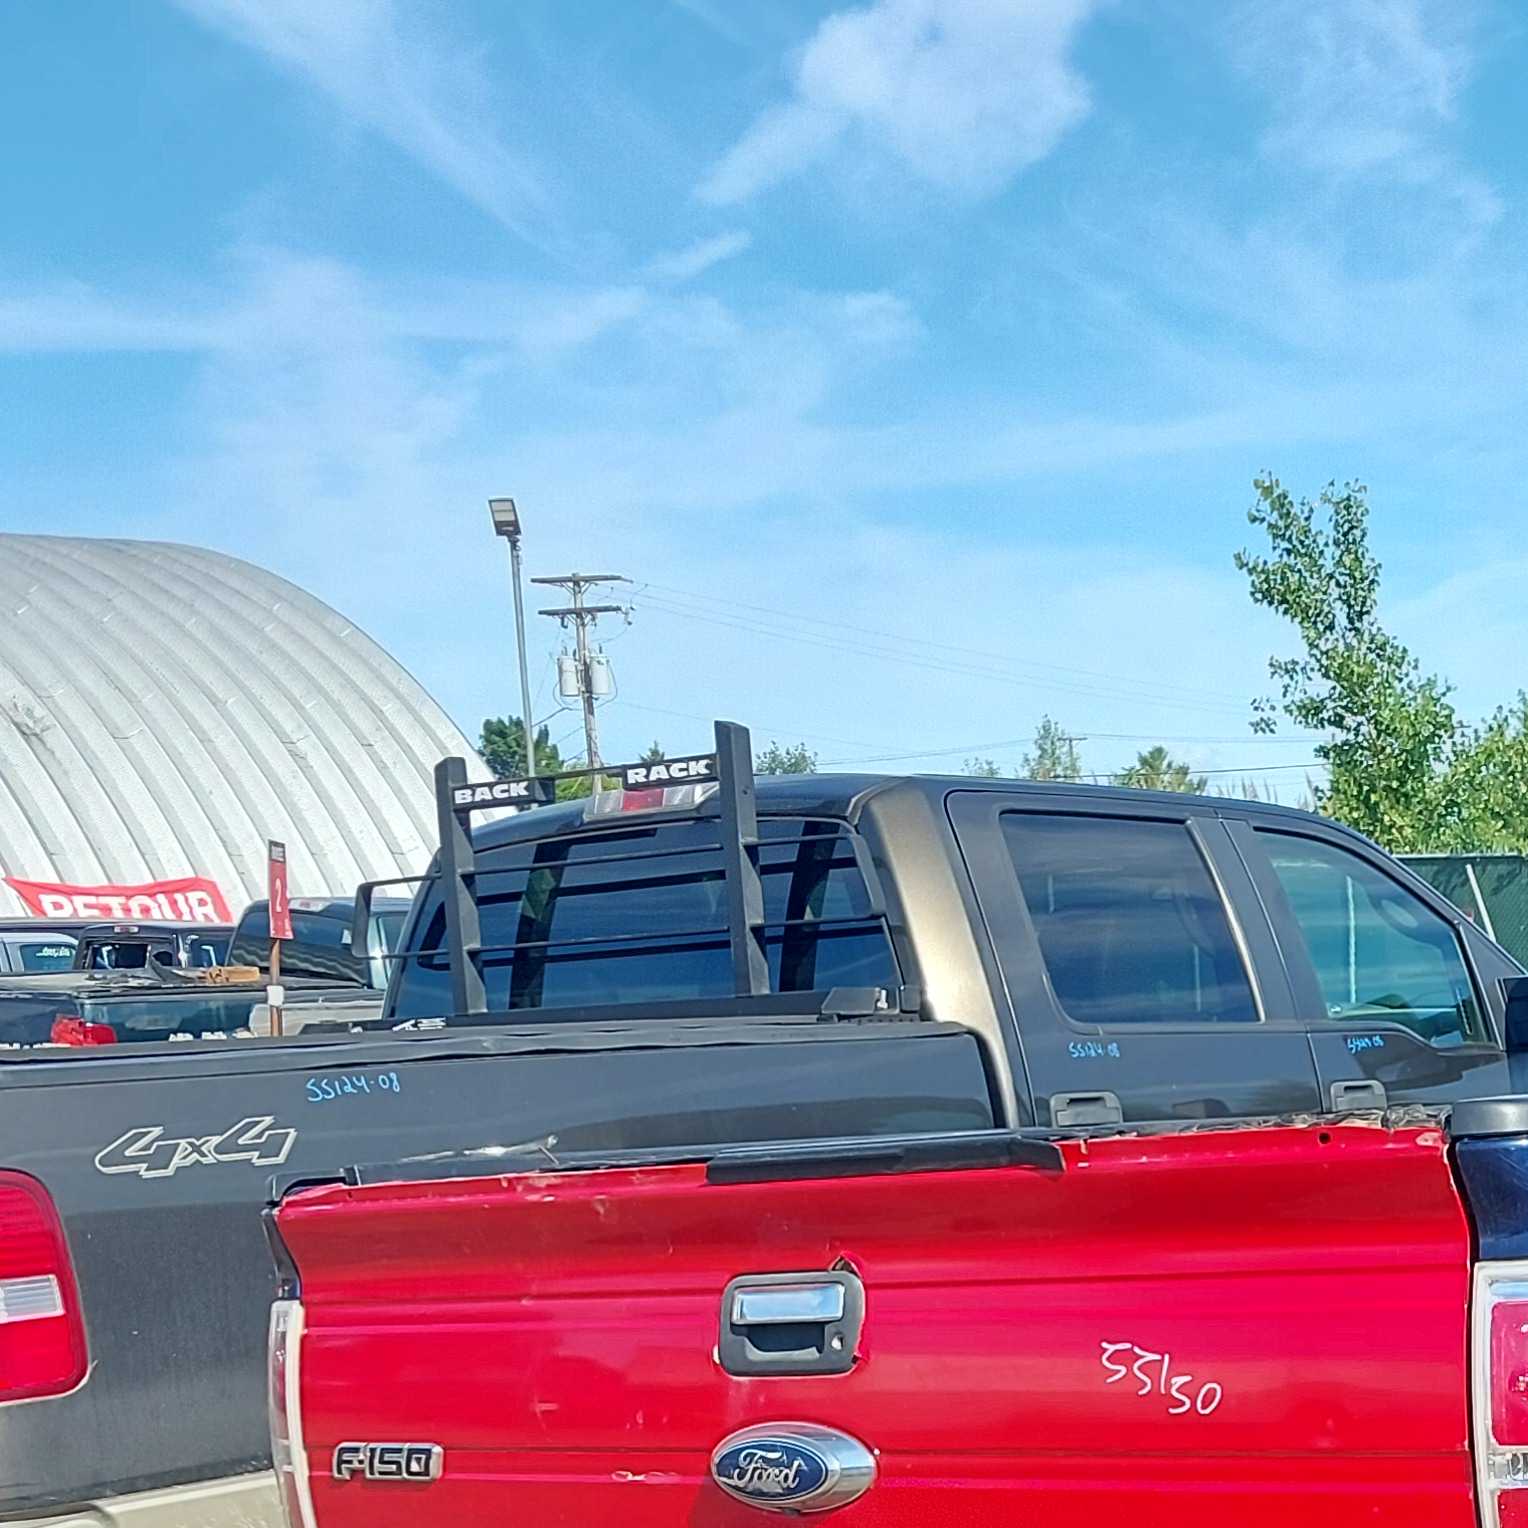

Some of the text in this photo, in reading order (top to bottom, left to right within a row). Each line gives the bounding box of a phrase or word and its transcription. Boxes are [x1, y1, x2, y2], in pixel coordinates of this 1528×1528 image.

[454, 759, 712, 804] BACK RACK
[733, 1448, 801, 1490] Ford
